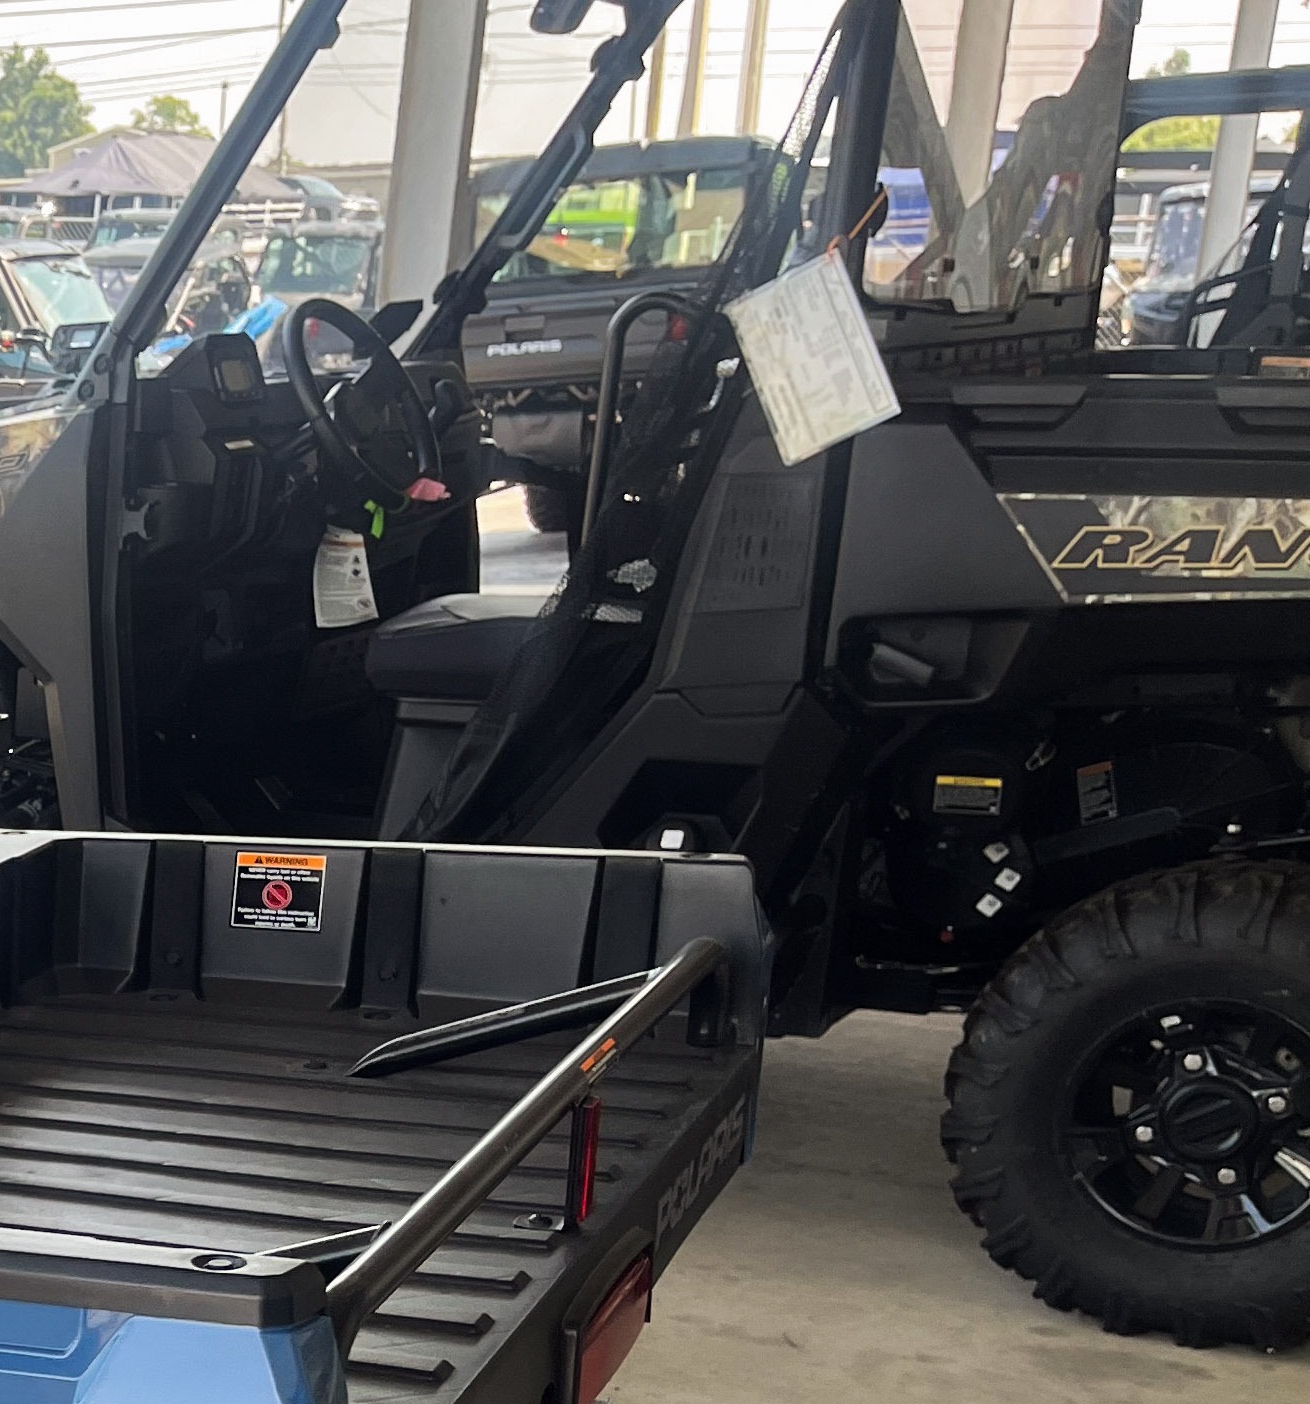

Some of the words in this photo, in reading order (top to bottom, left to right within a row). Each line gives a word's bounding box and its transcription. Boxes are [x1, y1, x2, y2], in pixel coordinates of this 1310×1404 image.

[486, 338, 563, 357] POLARIS
[1051, 525, 1310, 569] RAN
[264, 856, 309, 867] WARNING
